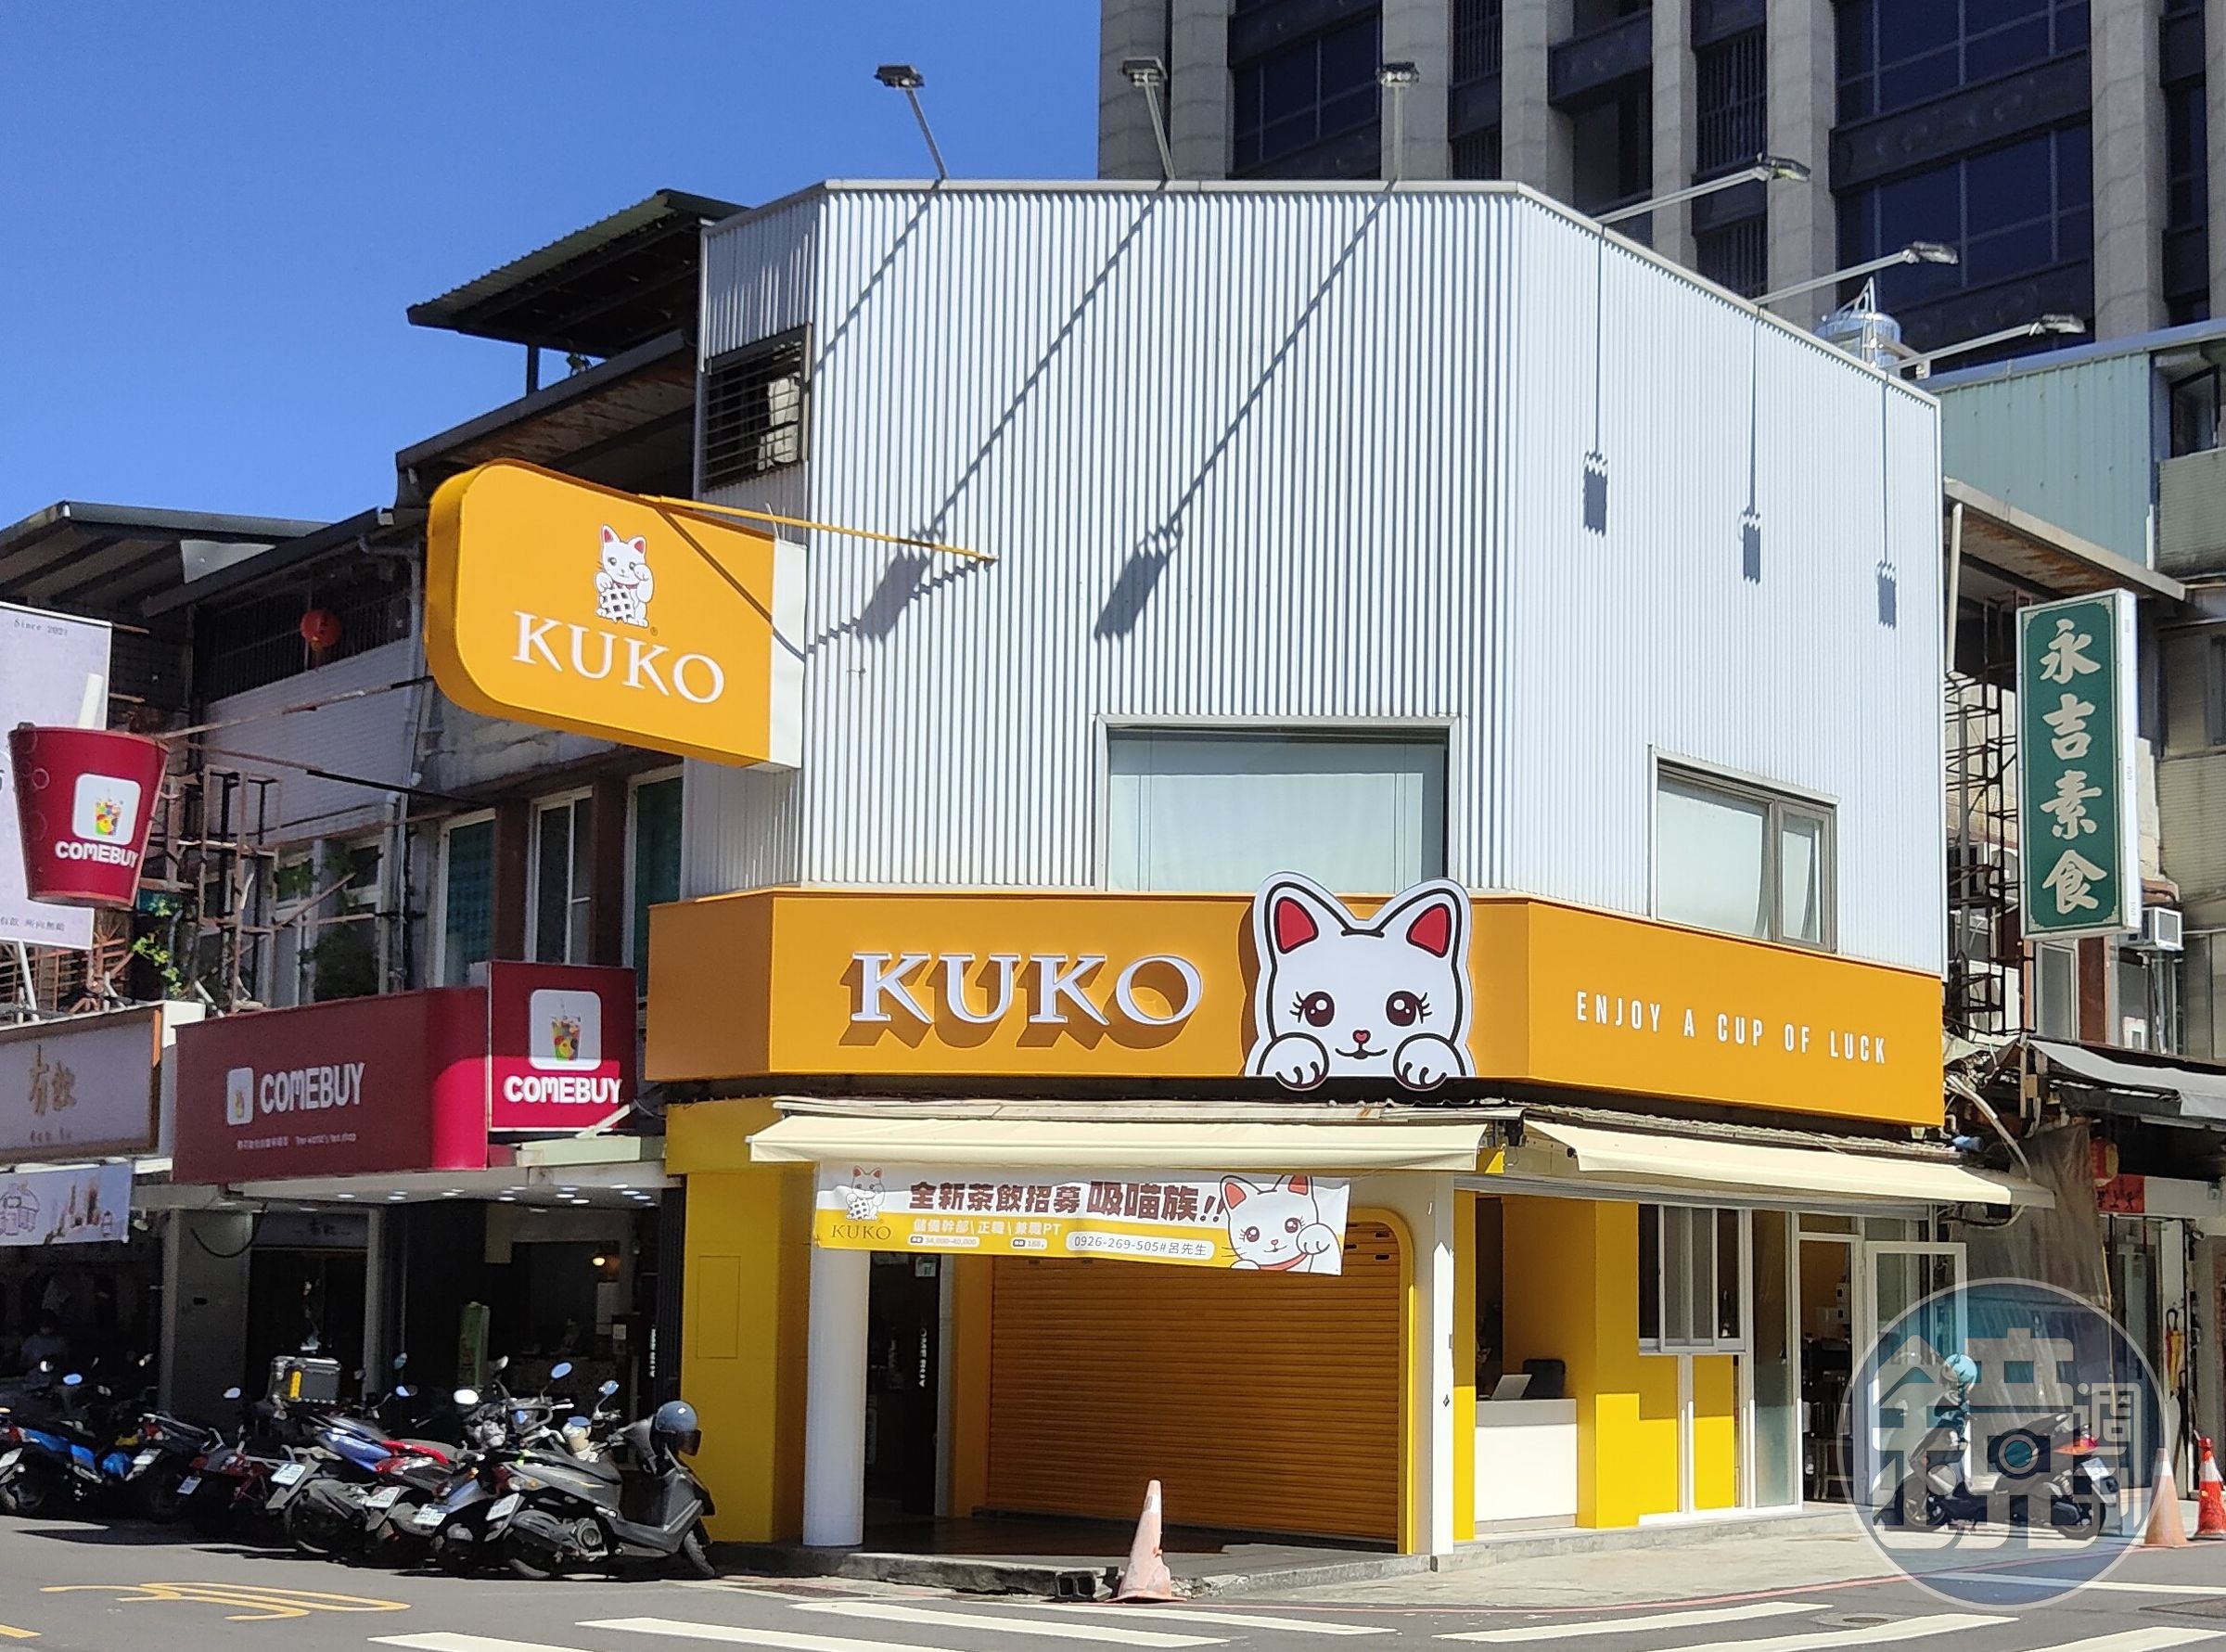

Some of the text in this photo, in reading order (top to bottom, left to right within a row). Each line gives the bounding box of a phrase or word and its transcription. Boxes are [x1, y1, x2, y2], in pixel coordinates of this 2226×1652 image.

[13, 618, 42, 632] Since
[512, 610, 725, 705] KUKO
[2039, 618, 2108, 915] 永吉素食
[55, 840, 139, 867] COMEBUY
[851, 952, 1204, 1026] KUKO
[1576, 991, 1887, 1065] ENJOY A CUP OF LUCK
[259, 1062, 365, 1114] COMEBUY
[504, 1075, 621, 1105] COMEBUY
[908, 1181, 1082, 1214] 全新茶飲招募
[832, 1223, 892, 1240] KUKO
[1073, 1236, 1208, 1257] 0926-269-505#呂先生
